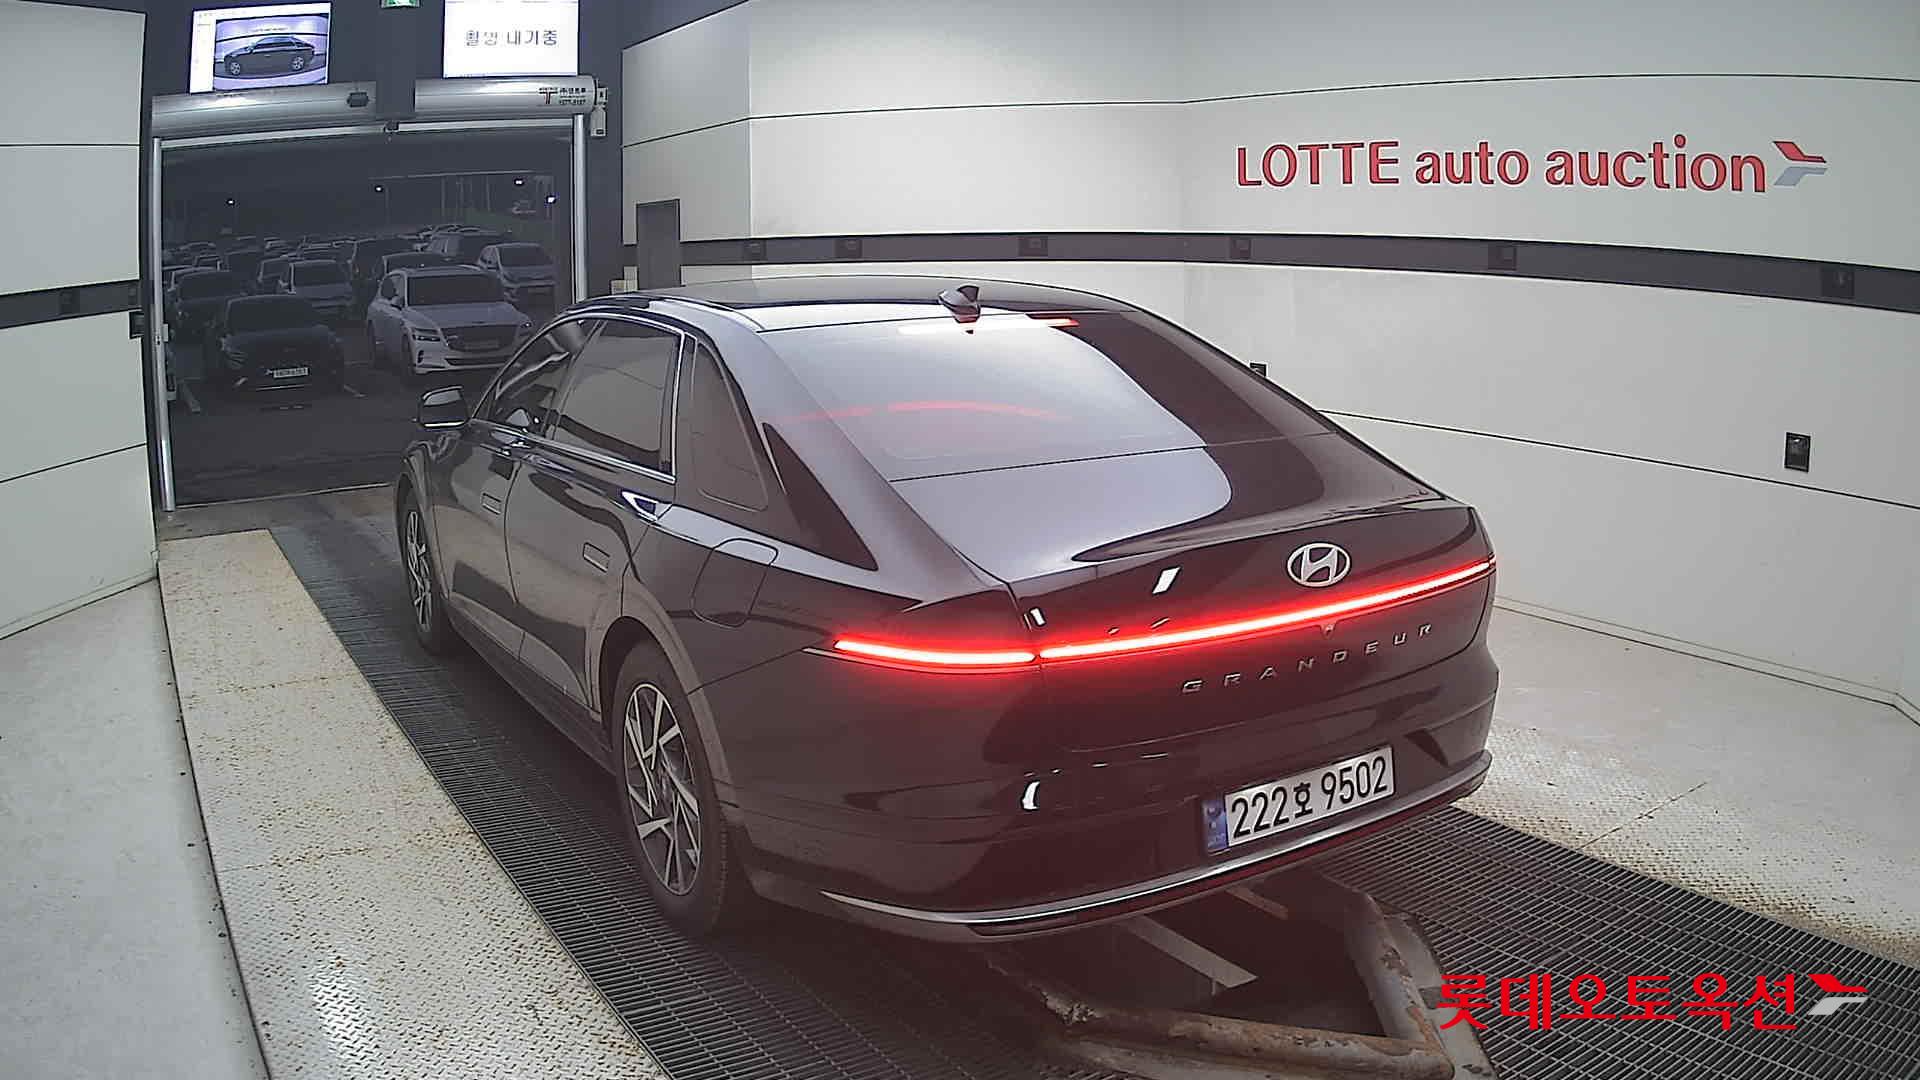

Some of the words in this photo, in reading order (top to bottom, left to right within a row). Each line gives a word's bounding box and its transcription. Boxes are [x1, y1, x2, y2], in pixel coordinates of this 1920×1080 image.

[1236, 140, 1400, 188] LOTTE
[1414, 140, 1530, 186] auto
[1544, 133, 1767, 193] auction
[1181, 622, 1433, 694] GRANDEUR
[1230, 782, 1314, 839] 222호
[1320, 755, 1388, 810] 9502
